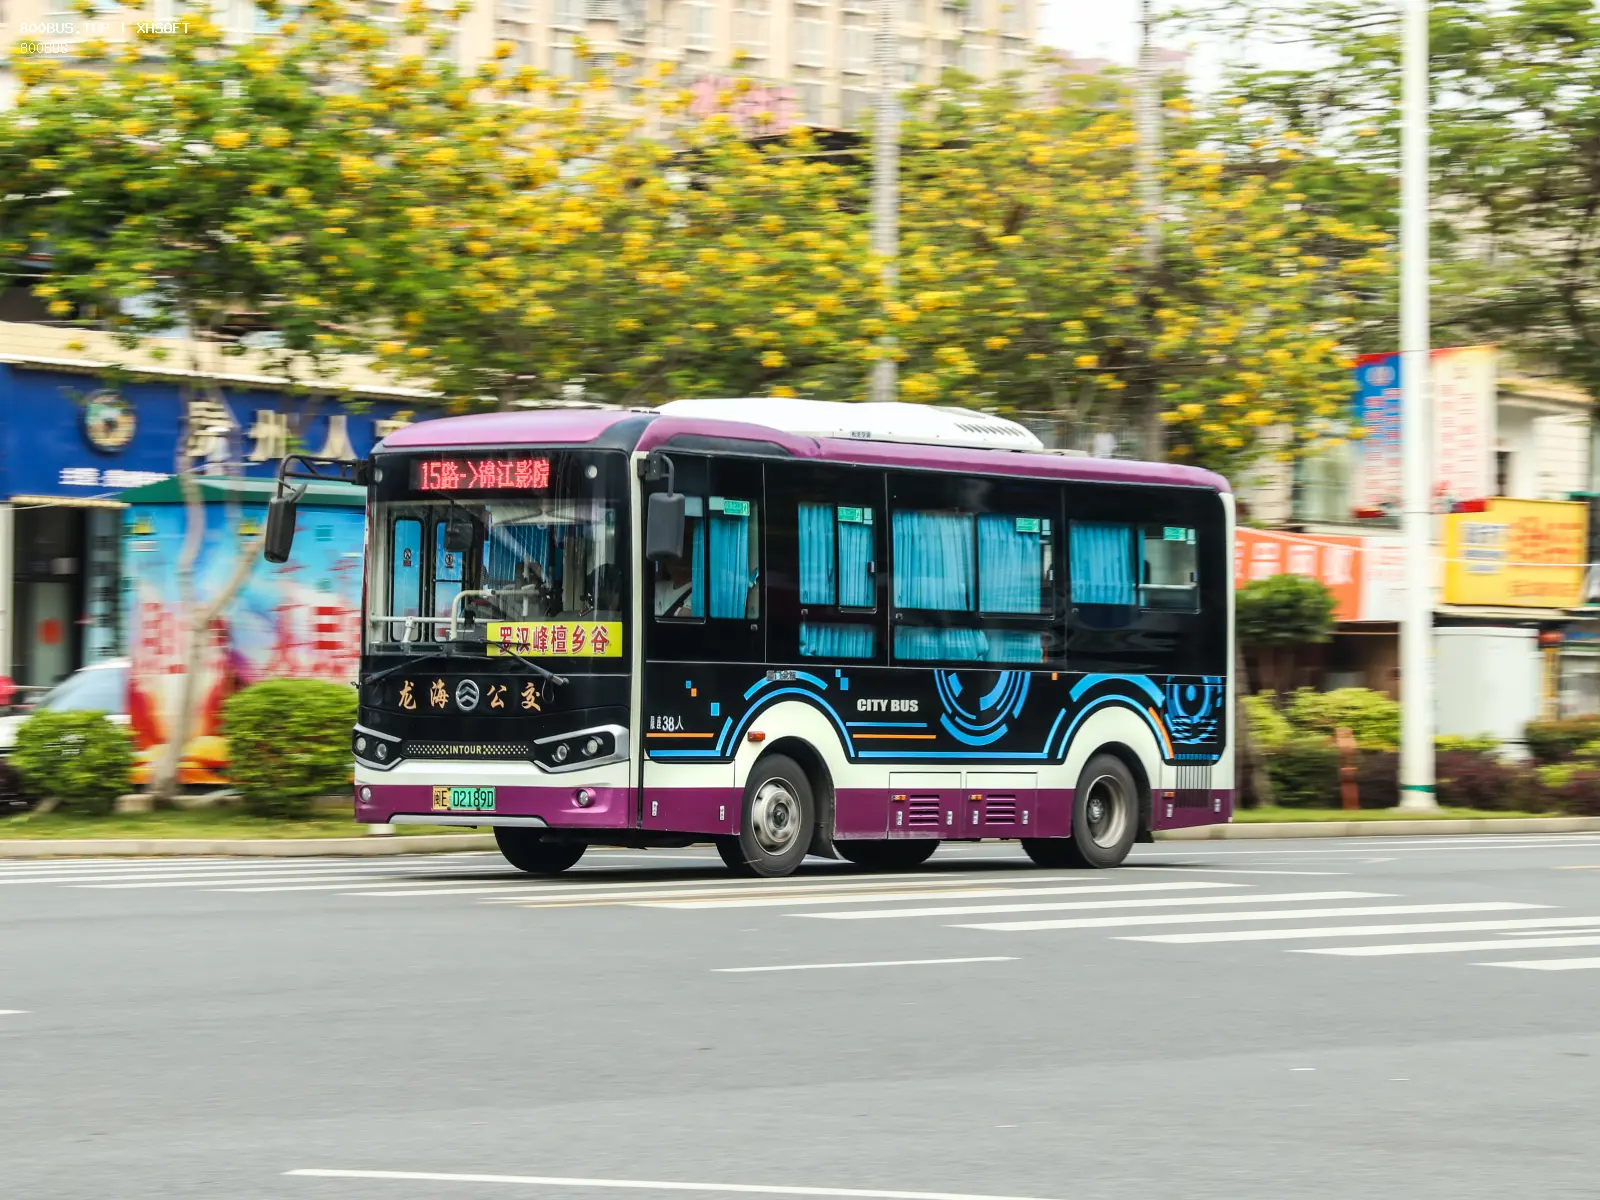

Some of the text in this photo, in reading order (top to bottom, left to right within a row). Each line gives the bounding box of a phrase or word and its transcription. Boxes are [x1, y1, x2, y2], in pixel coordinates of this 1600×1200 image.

[856, 698, 919, 712] CITY BUS
[449, 745, 482, 755] INTOUR
[453, 790, 494, 808] 02189D
